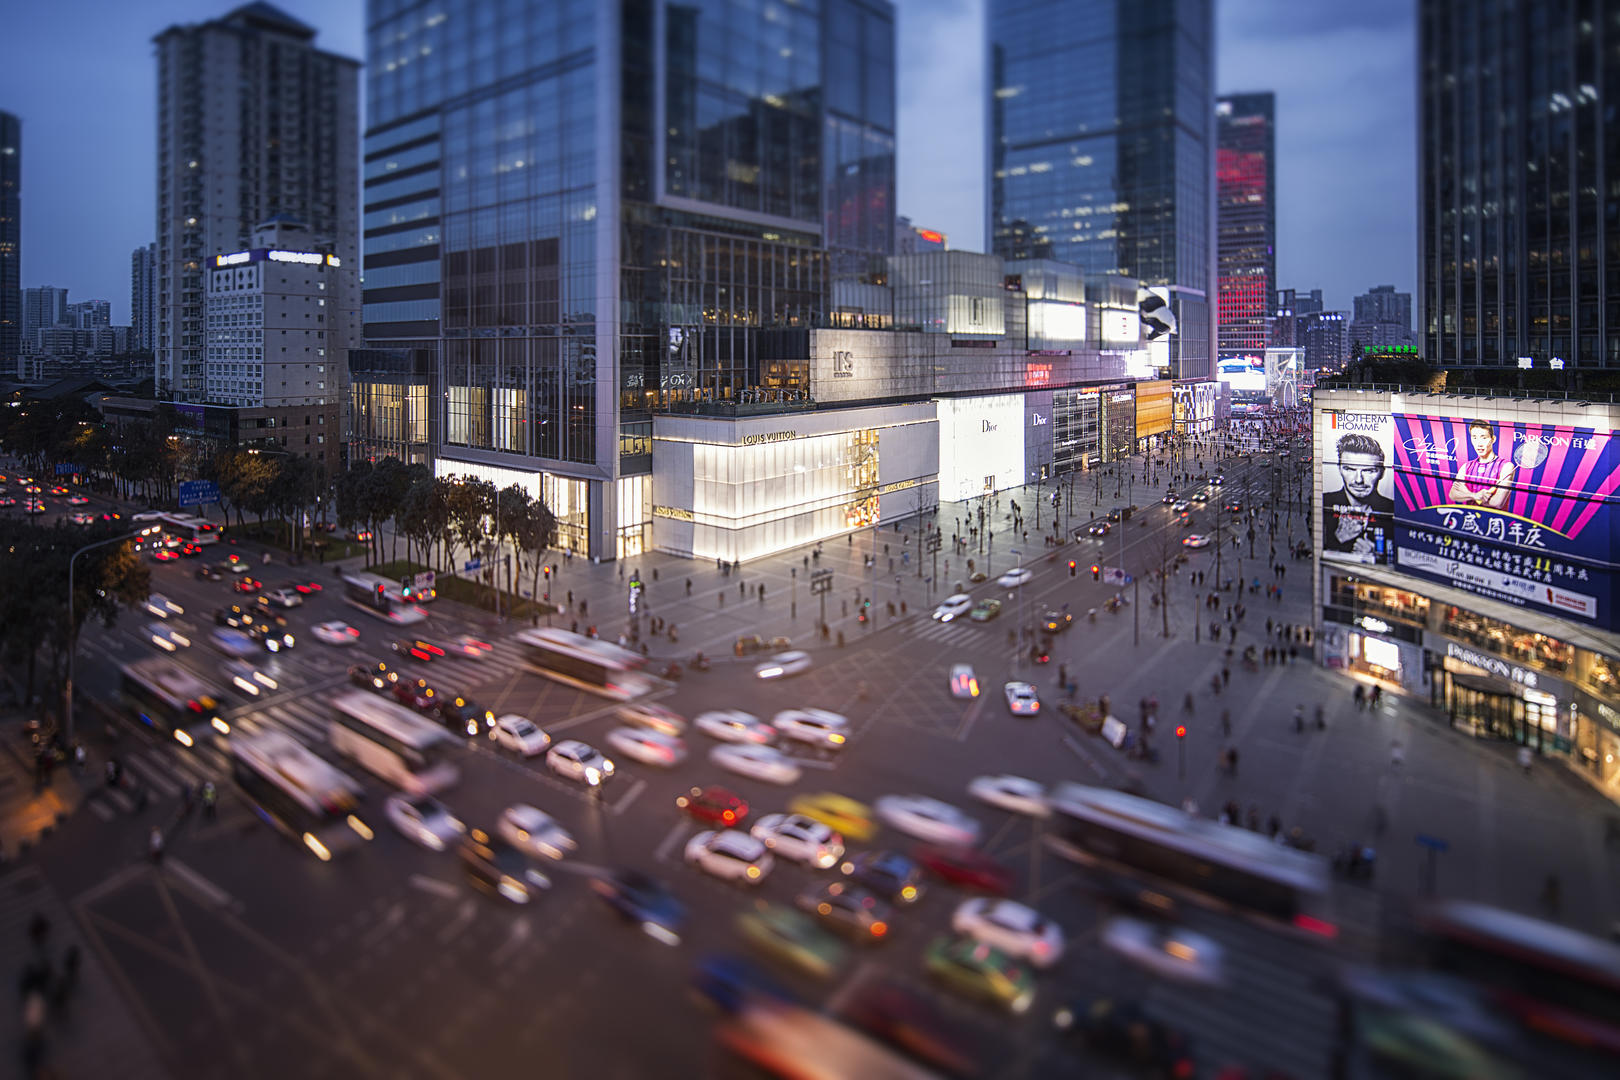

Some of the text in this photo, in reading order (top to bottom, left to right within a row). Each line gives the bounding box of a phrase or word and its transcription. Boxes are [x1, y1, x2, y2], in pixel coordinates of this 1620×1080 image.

[1033, 413, 1047, 426] Dior
[1337, 413, 1388, 424] BIOTHERM
[982, 419, 998, 433] Dior
[1337, 421, 1379, 432] HOMME
[743, 430, 796, 445] LOUIS VUITTON
[1513, 431, 1597, 451] PARKSON 百盛
[1436, 507, 1546, 547] 百盛周年庆
